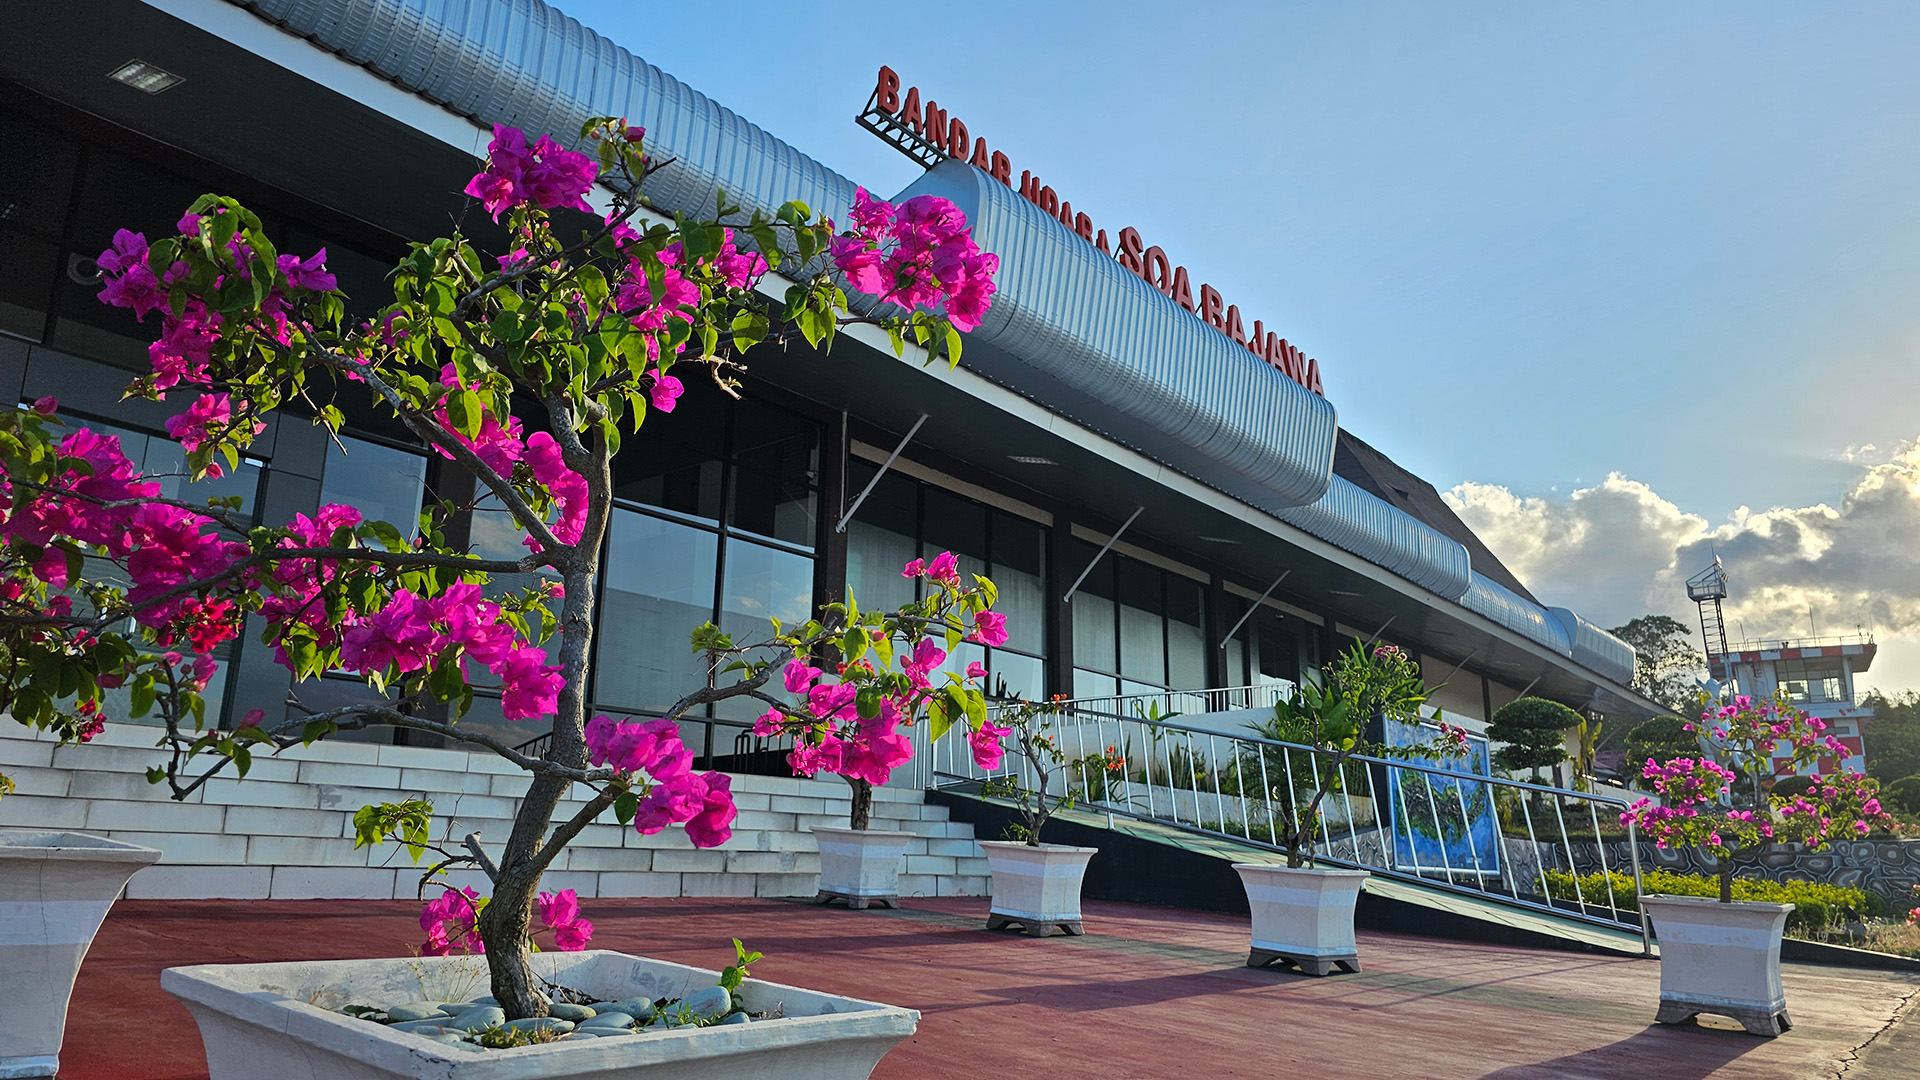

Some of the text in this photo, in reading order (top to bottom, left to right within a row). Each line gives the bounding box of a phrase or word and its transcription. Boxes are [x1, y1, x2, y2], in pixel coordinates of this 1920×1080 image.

[878, 65, 1012, 188] BANDAR
[1119, 226, 1196, 315] SOA
[1201, 283, 1324, 398] BAJAWA
